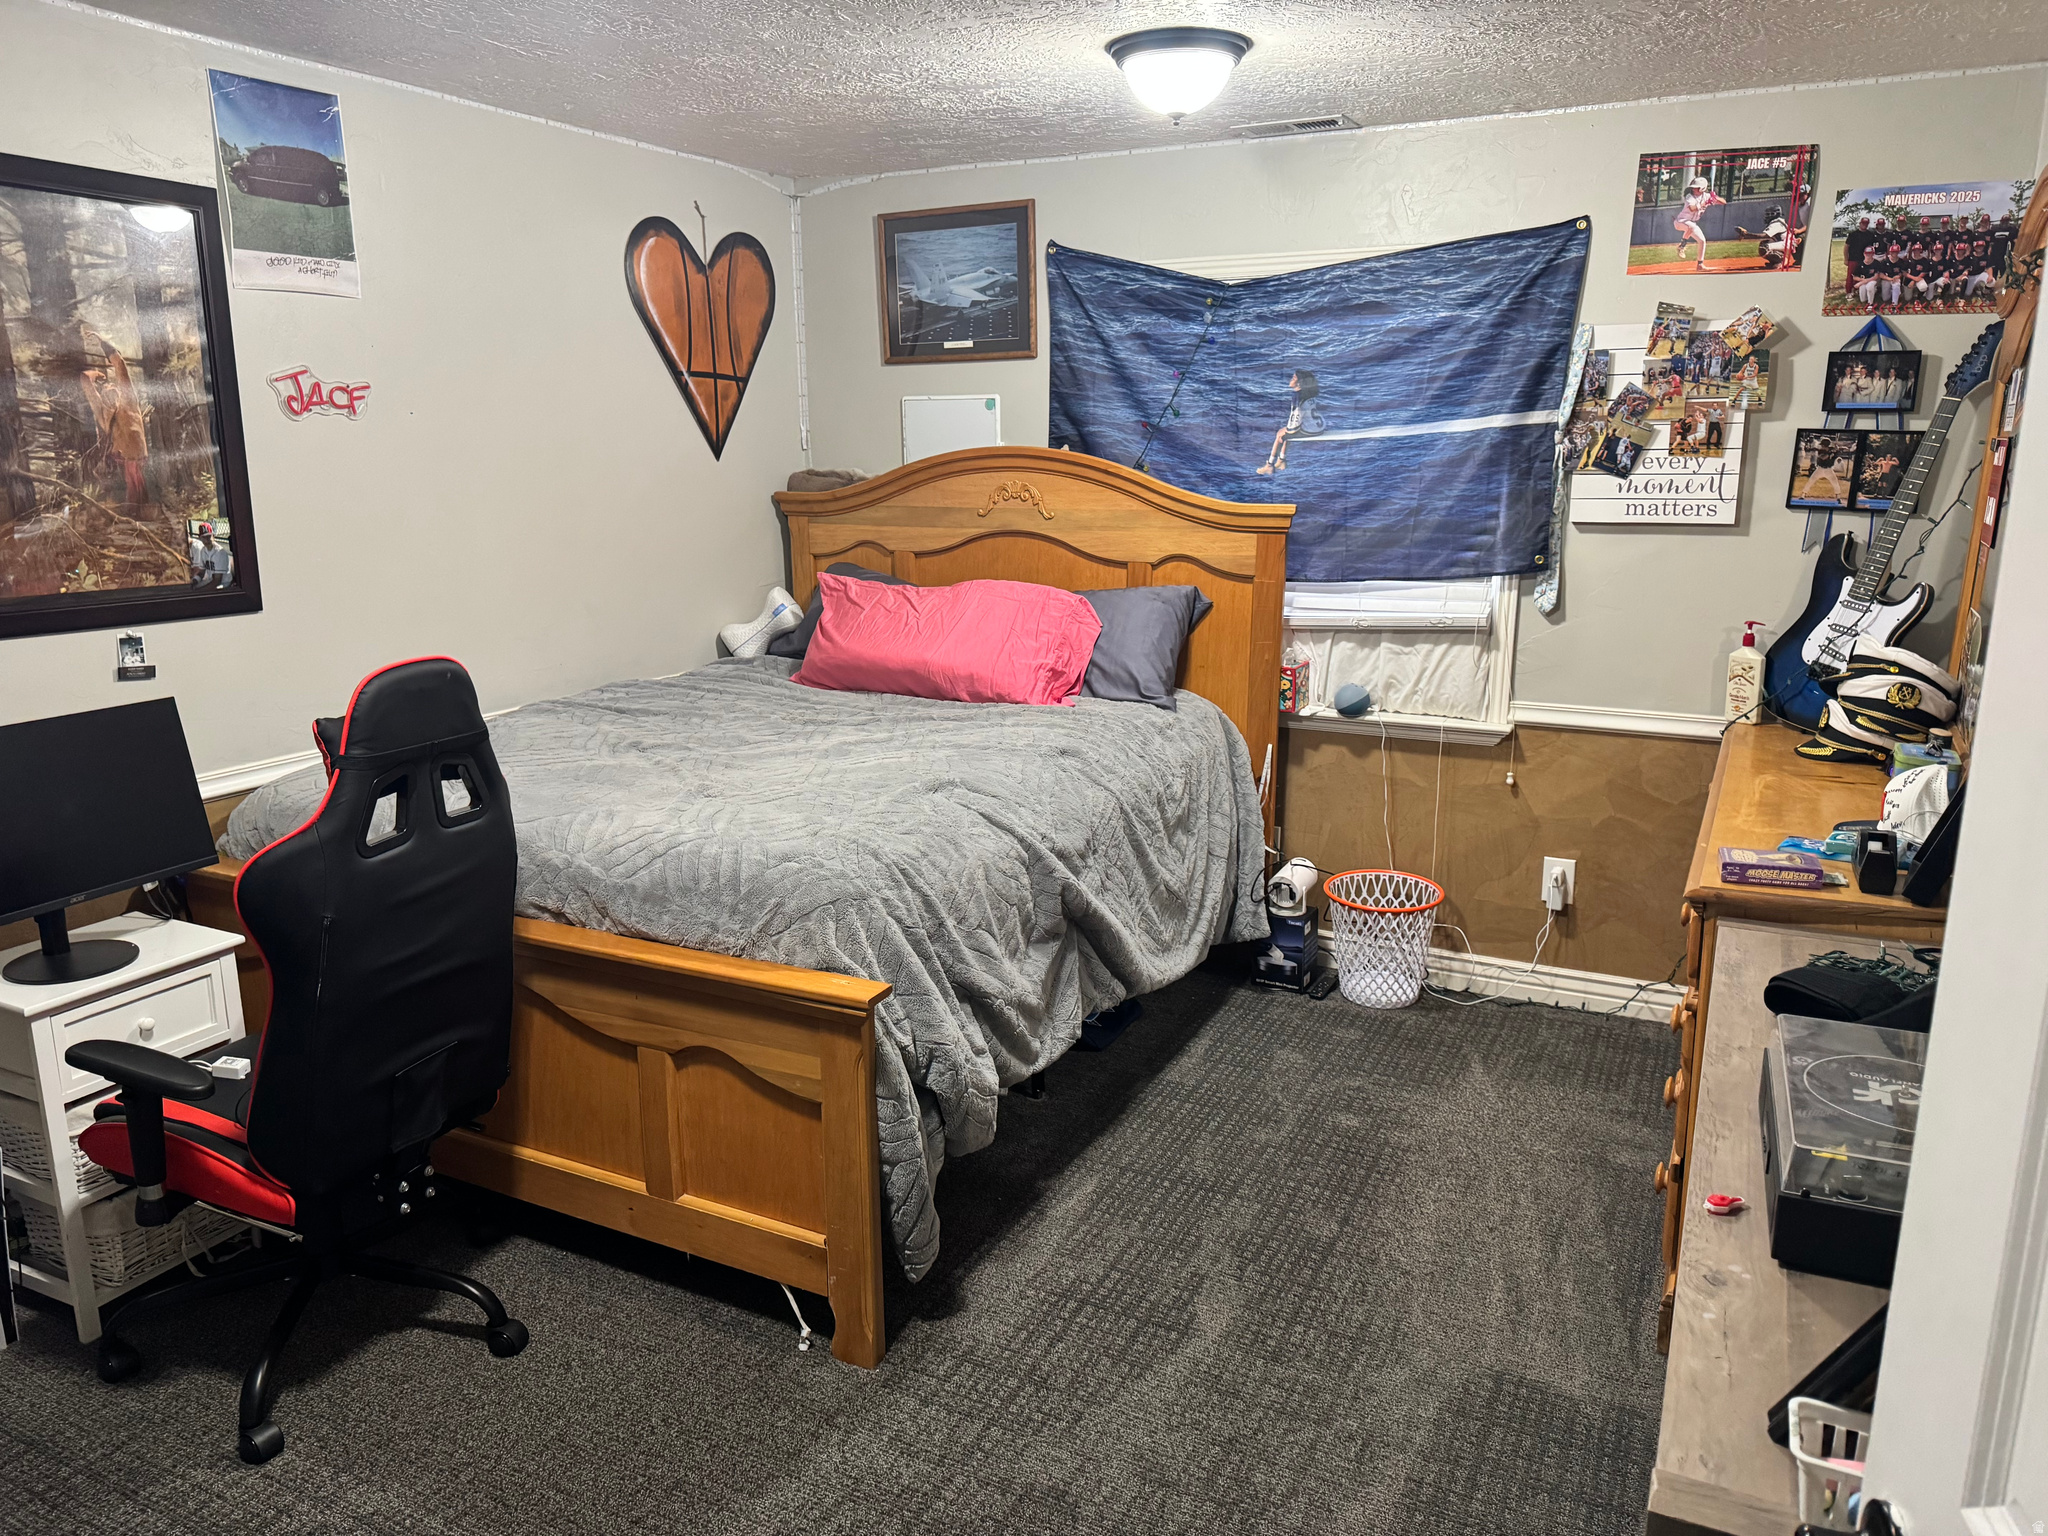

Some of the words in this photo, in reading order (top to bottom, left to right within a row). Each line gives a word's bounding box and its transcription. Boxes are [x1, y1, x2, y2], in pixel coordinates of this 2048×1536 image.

[1746, 157, 1771, 170] JACE
[1771, 156, 1787, 168] #5
[1884, 192, 1946, 207] MAVERICKS
[1950, 190, 1981, 203] 2025
[1641, 456, 1706, 474] every
[1616, 462, 1736, 504] moment
[1624, 499, 1718, 517] matters
[1745, 869, 1779, 879] MOOSE
[1779, 870, 1817, 881] MASTER
[1849, 1071, 1888, 1082] AUDIO
